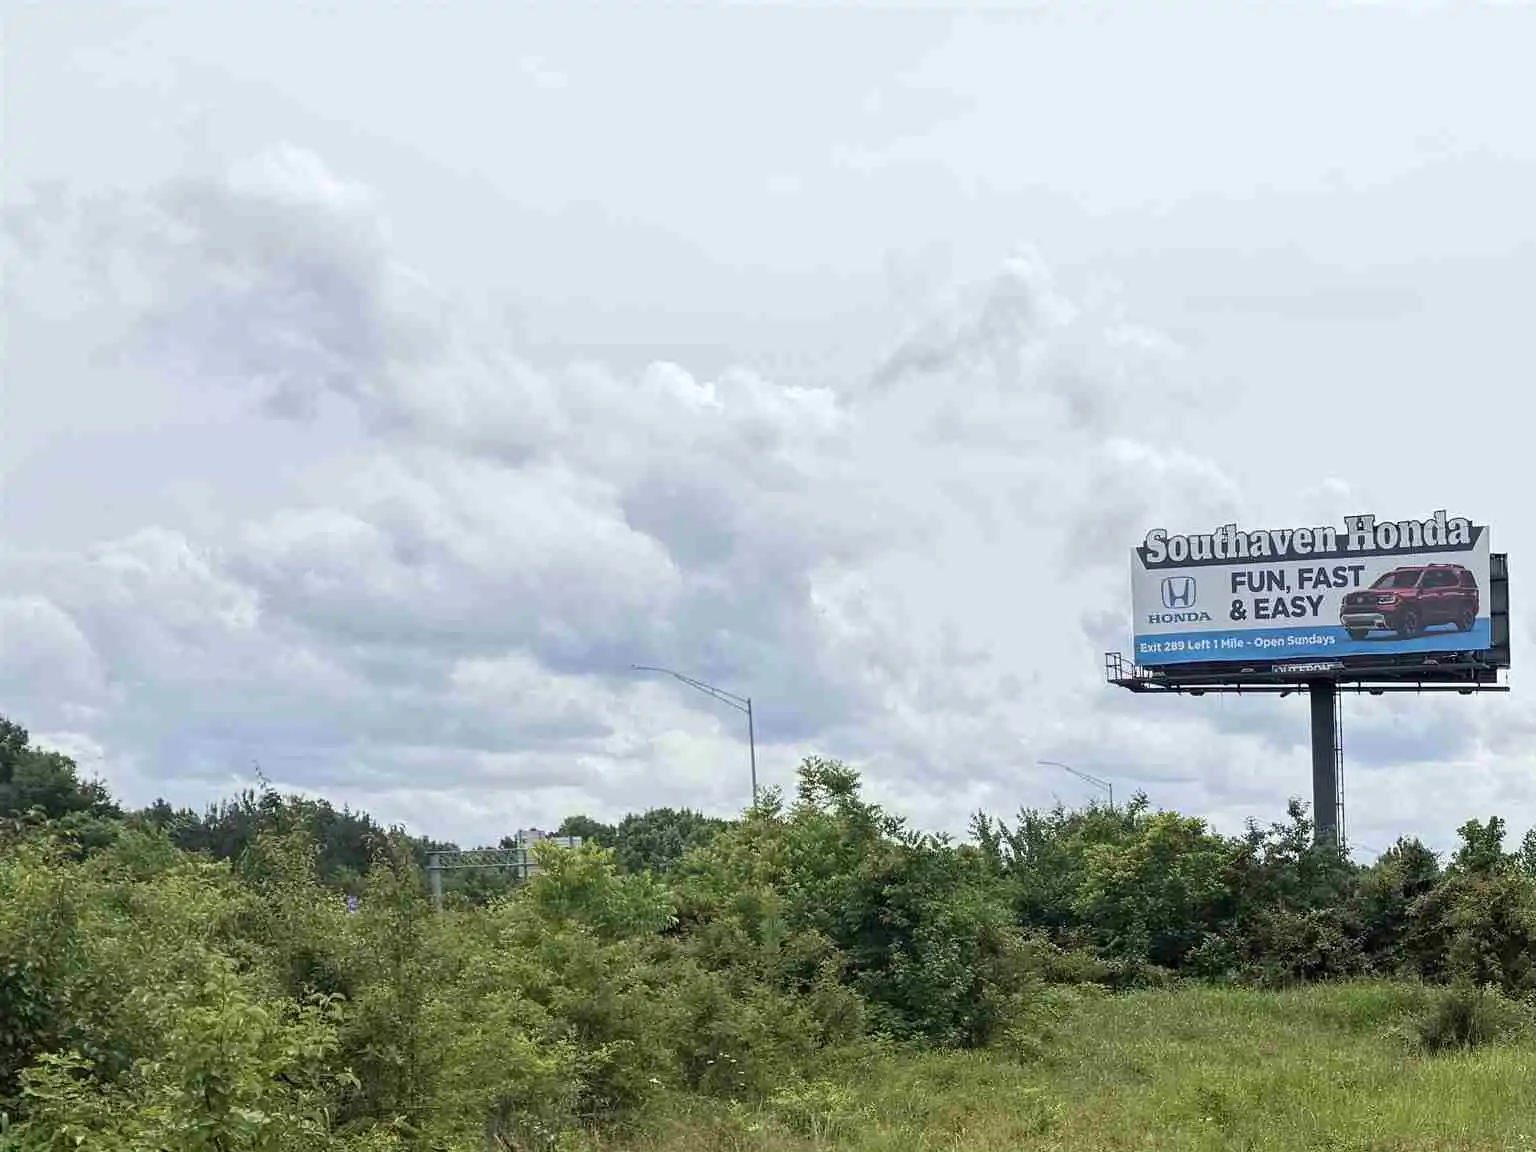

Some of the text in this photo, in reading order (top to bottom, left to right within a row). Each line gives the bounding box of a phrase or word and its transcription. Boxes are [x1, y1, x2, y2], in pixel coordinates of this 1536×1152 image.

[1145, 509, 1473, 564] Southaven Honda
[1231, 565, 1366, 594] FUN, FAST
[1148, 611, 1212, 624] HONDA
[1230, 595, 1324, 621] & EASY
[1139, 643, 1161, 653] Exit
[1165, 640, 1185, 651] 289
[1188, 638, 1211, 650] Left
[1221, 636, 1243, 648] Mile
[1254, 637, 1285, 648] Open
[1287, 633, 1336, 647] Sundays
